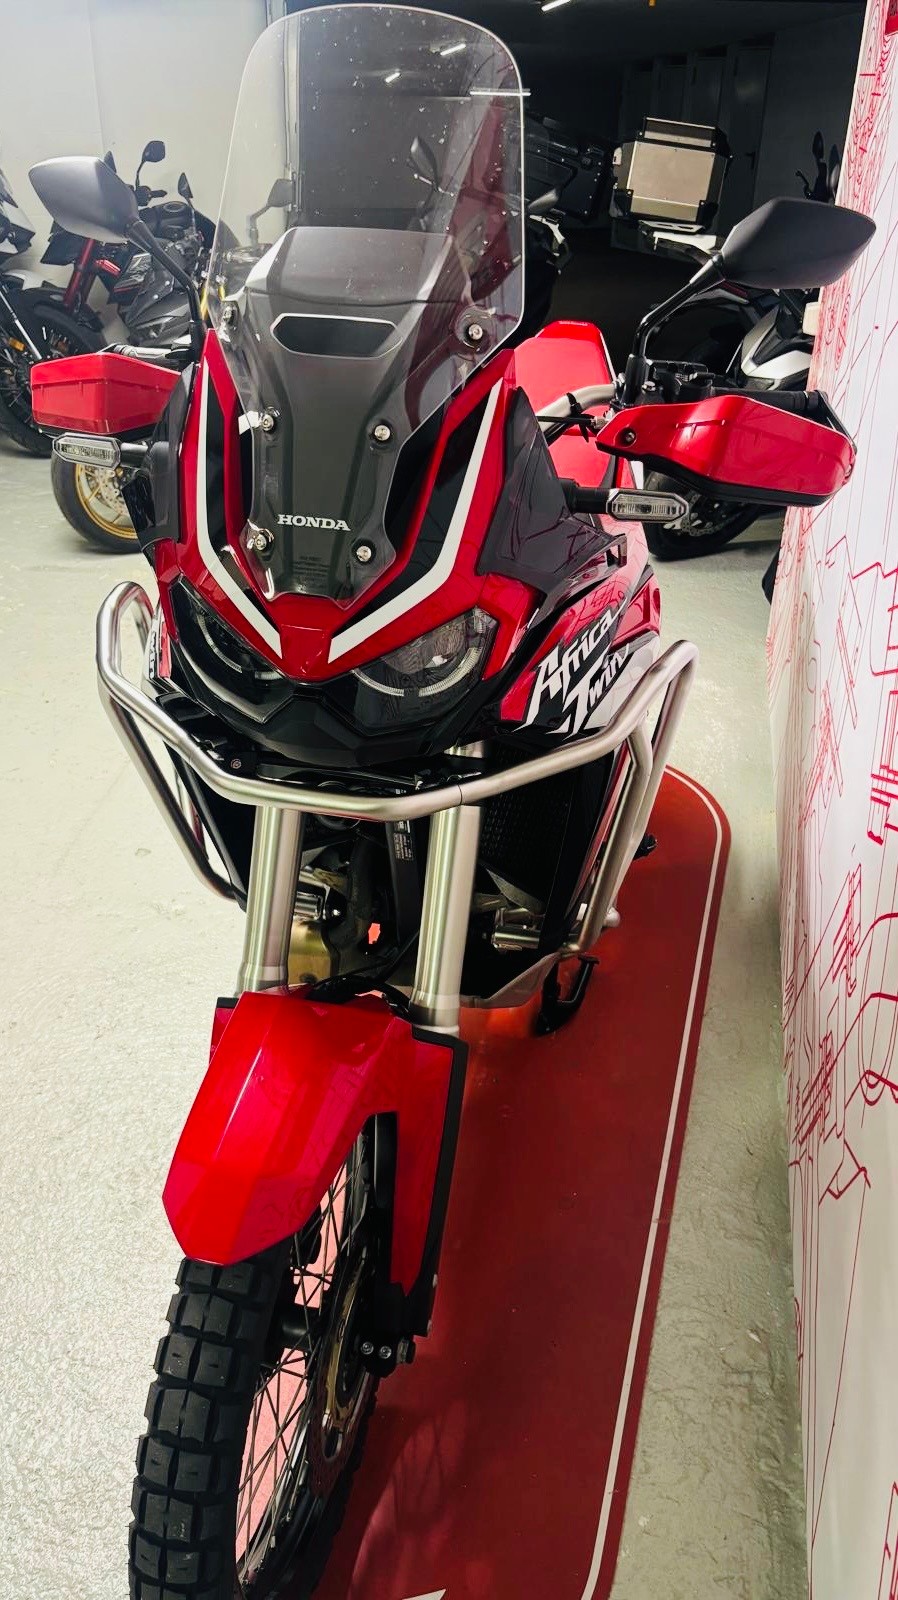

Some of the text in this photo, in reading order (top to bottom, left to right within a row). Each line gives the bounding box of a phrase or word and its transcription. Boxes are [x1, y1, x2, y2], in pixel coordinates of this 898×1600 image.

[277, 514, 351, 531] HONDA
[512, 597, 627, 732] Africa
[546, 641, 629, 741] Twin
